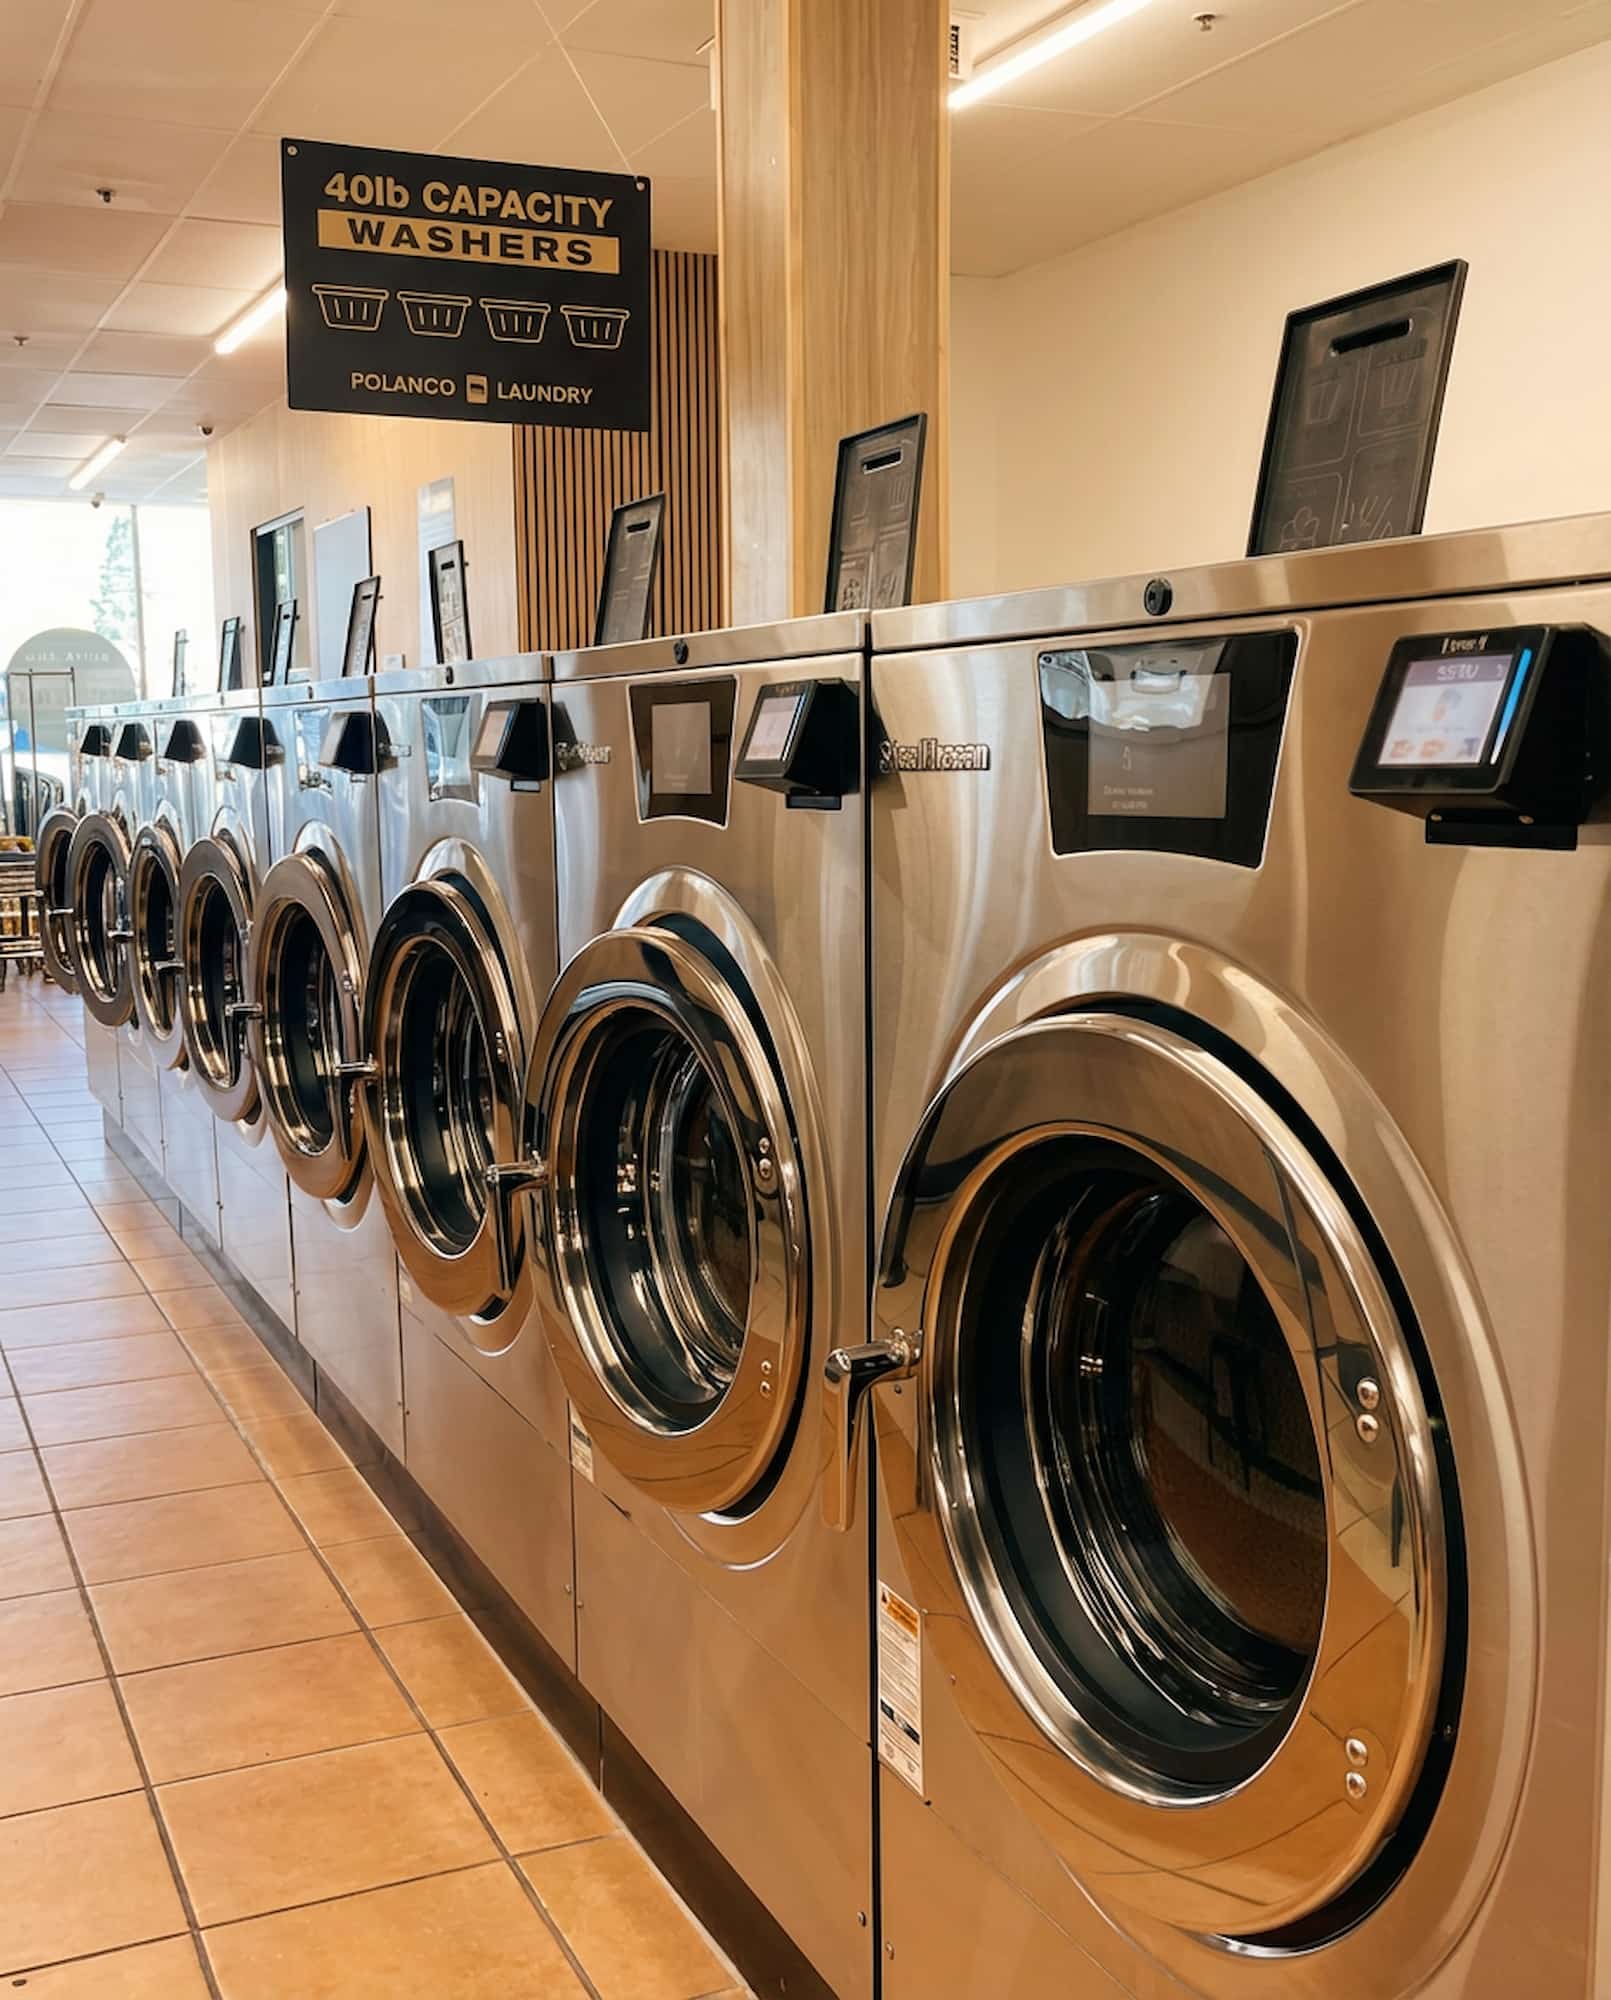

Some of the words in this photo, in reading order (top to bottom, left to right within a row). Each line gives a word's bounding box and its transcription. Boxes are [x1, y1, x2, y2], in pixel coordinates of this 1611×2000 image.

[324, 172, 410, 209] 40lb
[422, 181, 613, 228] CAPACITY
[347, 217, 593, 266] WASHERS
[351, 372, 456, 396] POLANCO
[497, 382, 593, 404] LAUNDRY
